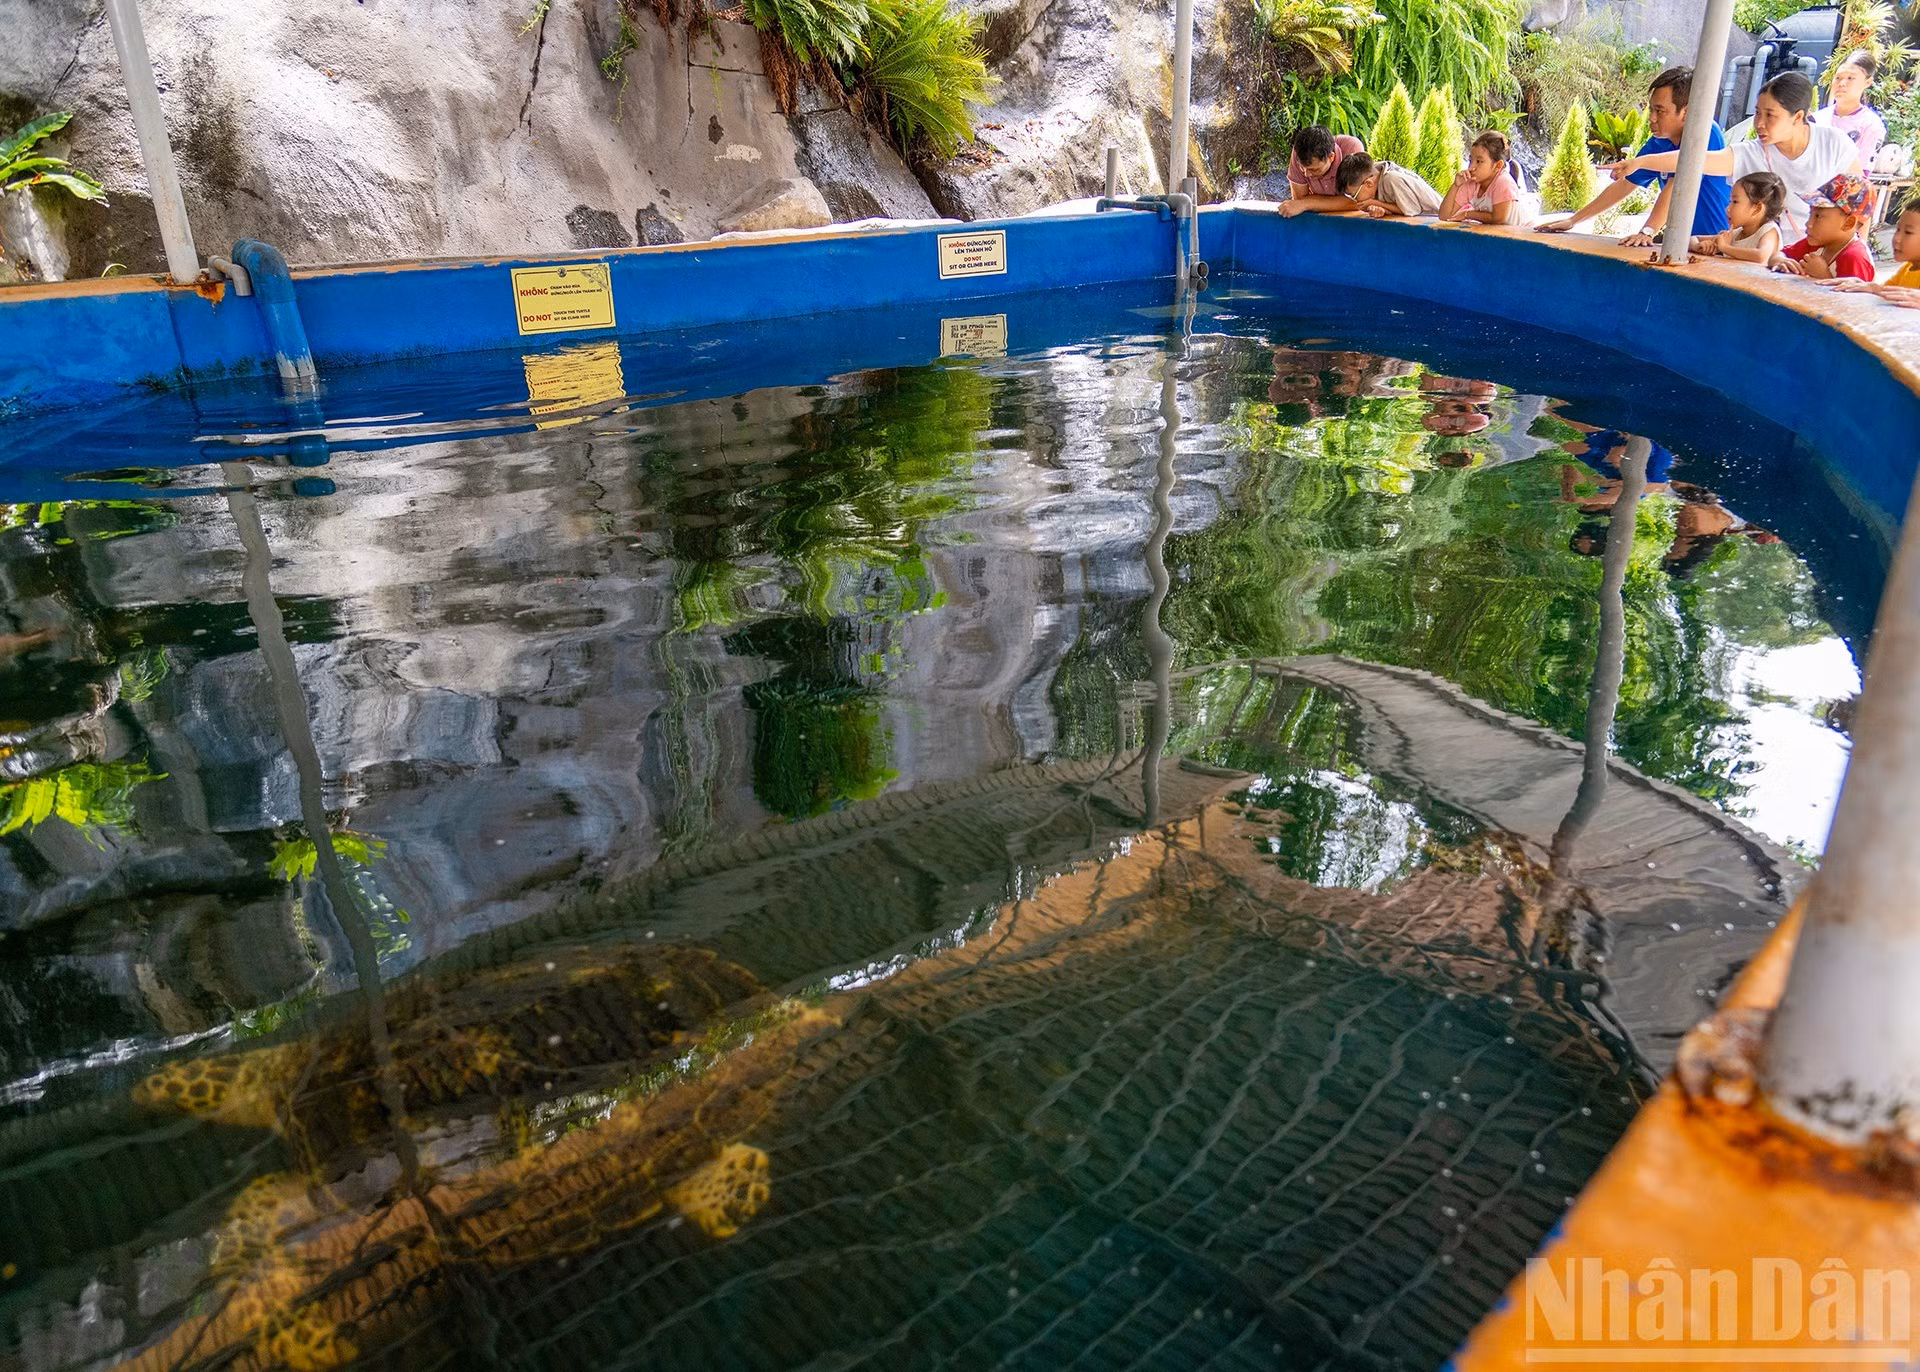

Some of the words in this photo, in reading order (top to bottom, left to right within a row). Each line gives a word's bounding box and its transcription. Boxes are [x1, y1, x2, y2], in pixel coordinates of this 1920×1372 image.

[949, 240, 966, 248] KHÔNG
[520, 287, 549, 296] KHÔNG
[523, 315, 535, 323] DO
[535, 314, 552, 322] NOT
